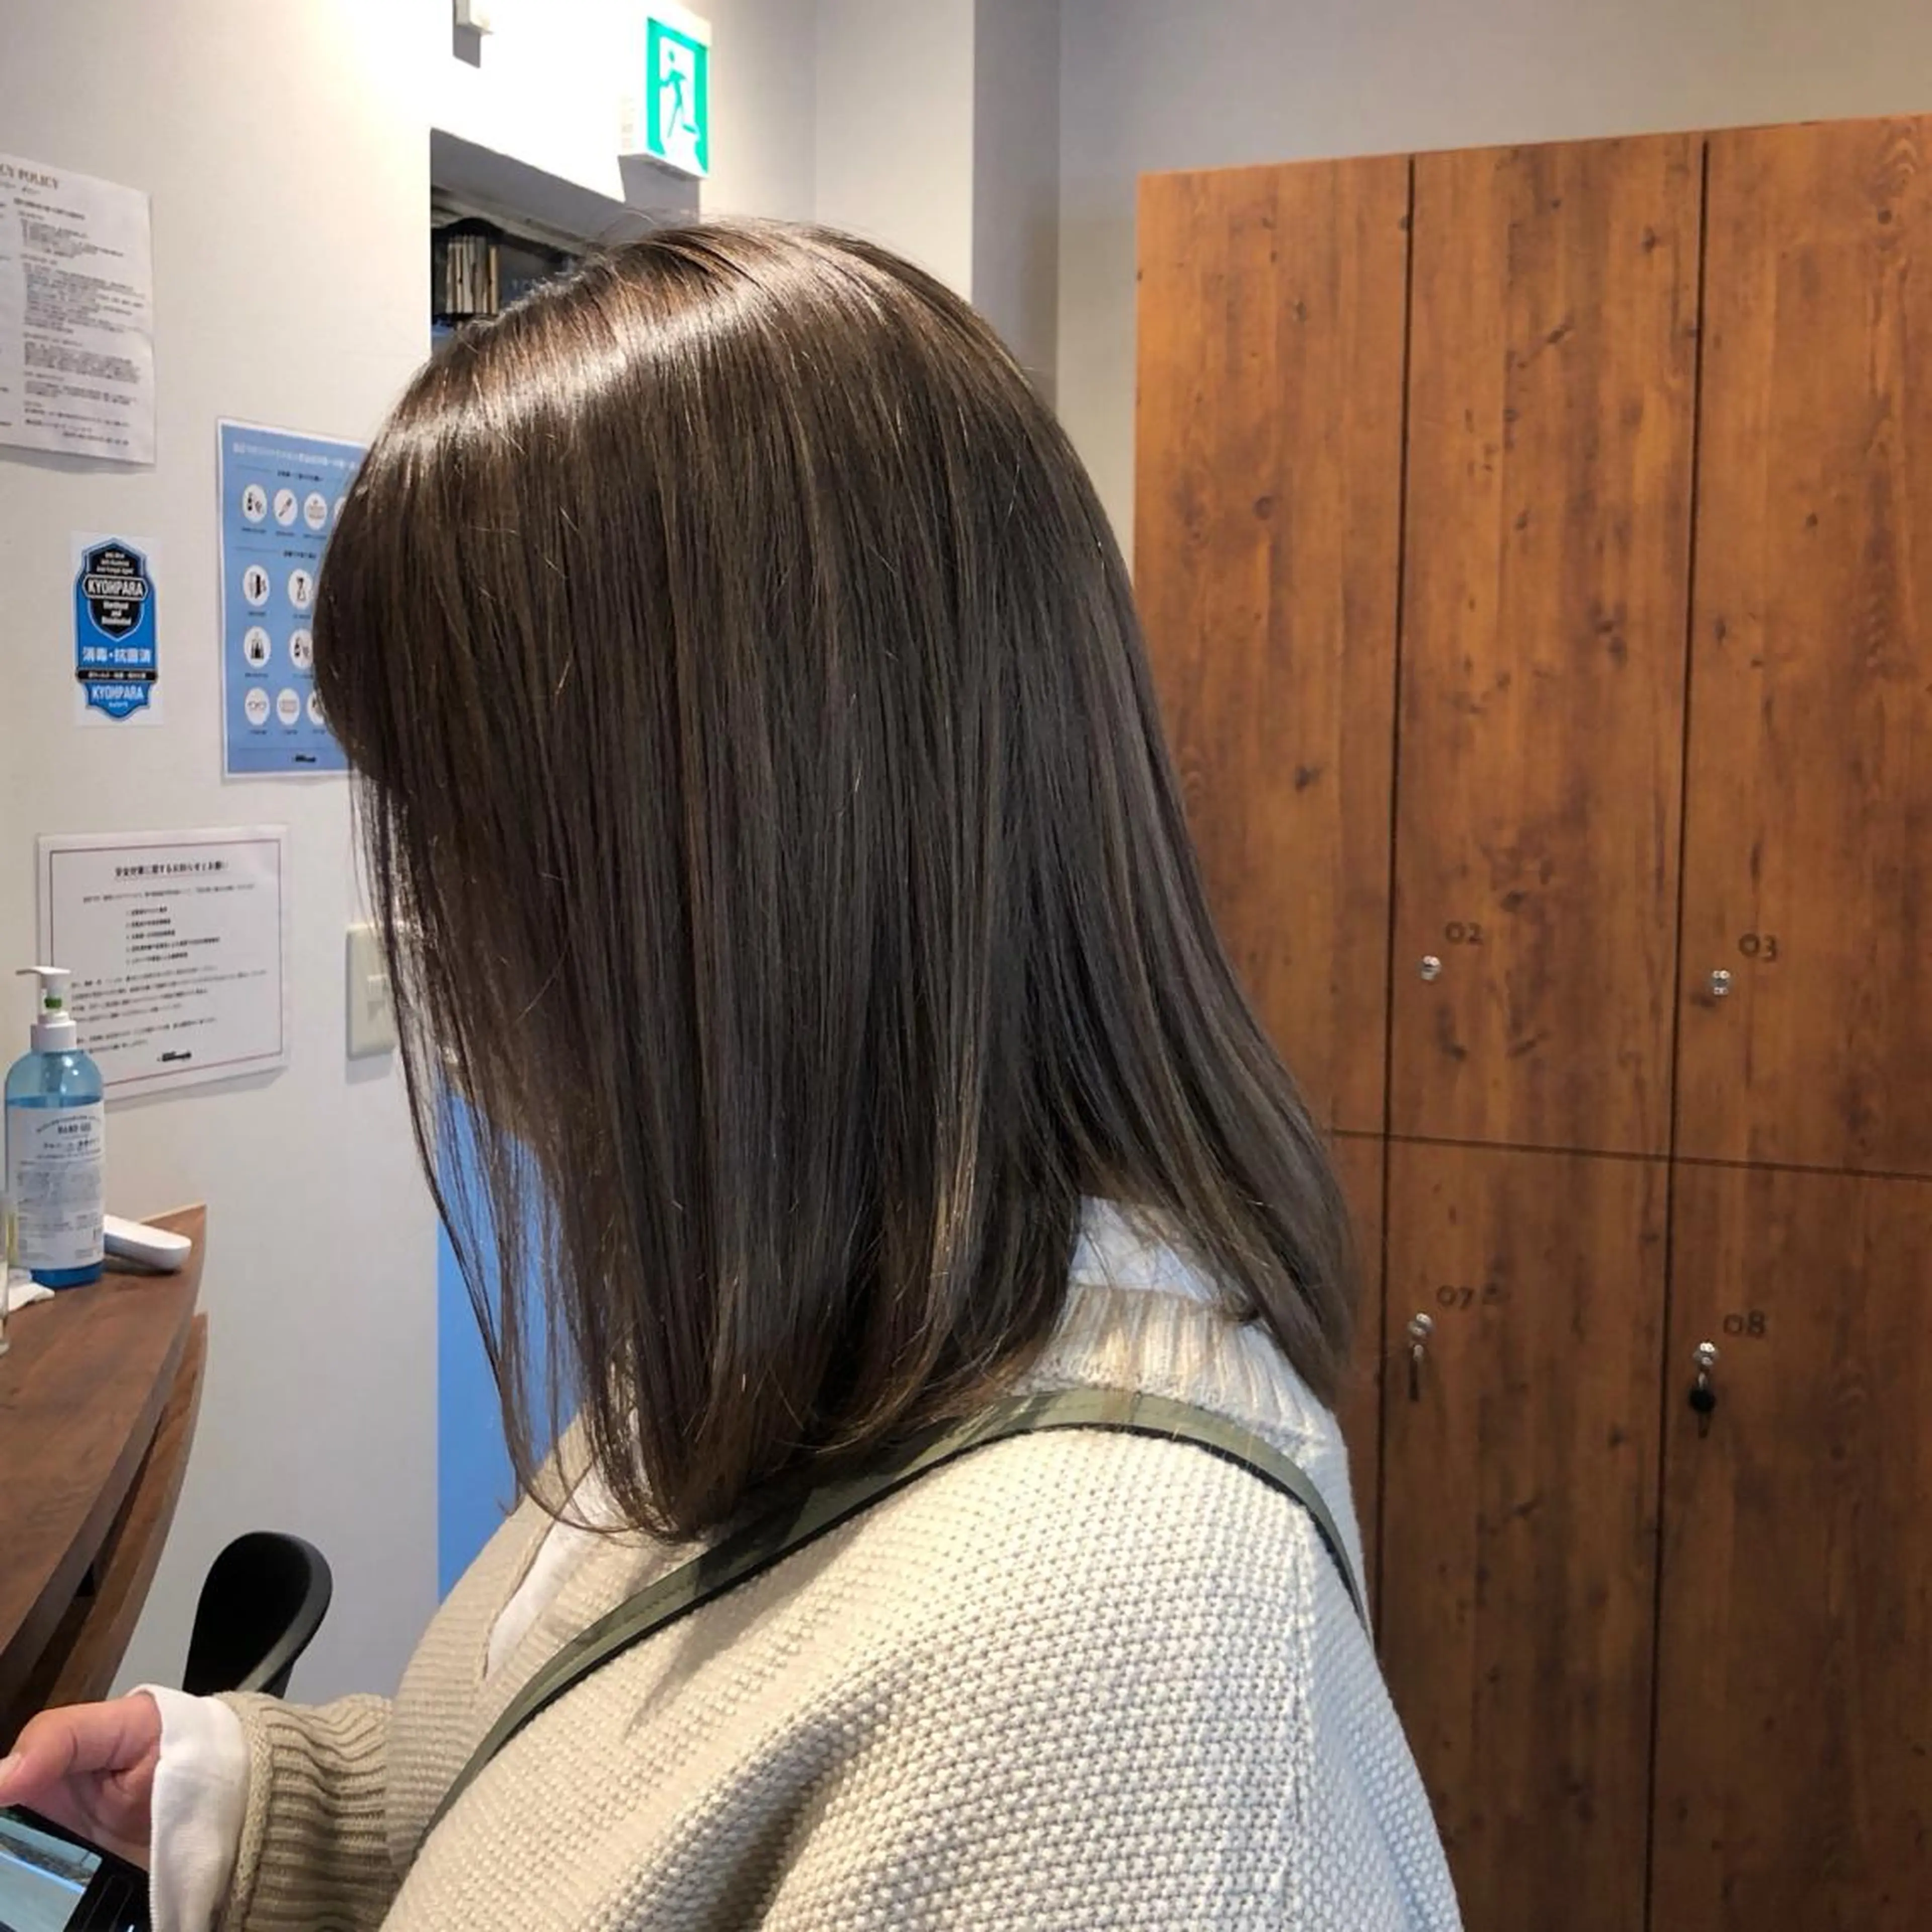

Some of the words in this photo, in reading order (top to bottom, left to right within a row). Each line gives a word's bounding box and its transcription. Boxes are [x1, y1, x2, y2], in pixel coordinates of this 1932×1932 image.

[18, 168, 58, 191] POLICY
[1444, 921, 1484, 945] 02
[1738, 933, 1777, 963] 03
[1436, 1284, 1474, 1310] 07
[1723, 1309, 1765, 1339] 08
